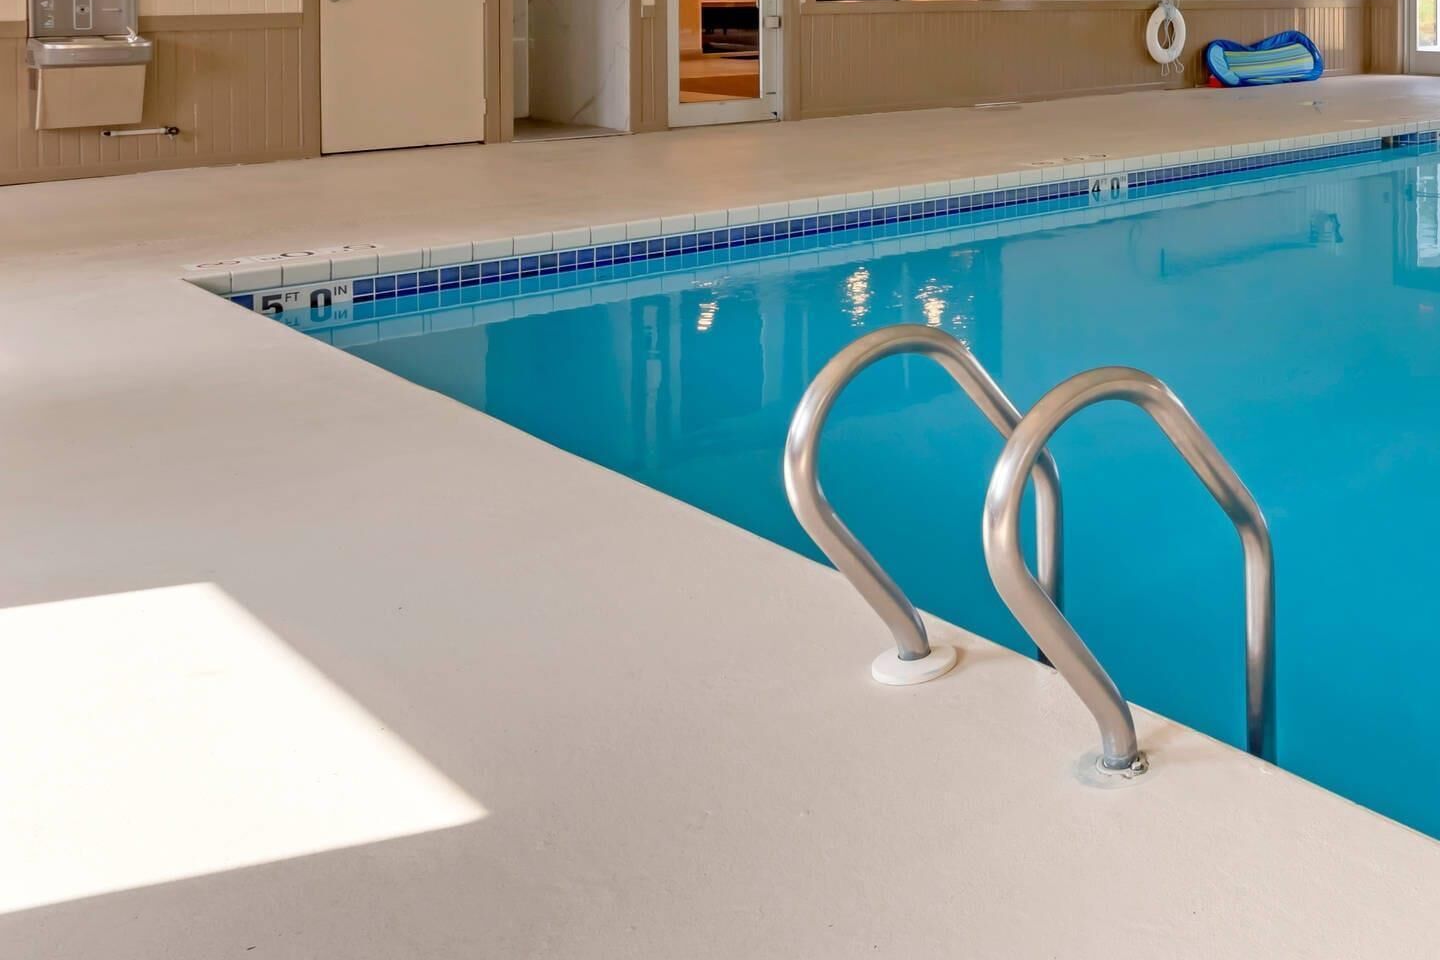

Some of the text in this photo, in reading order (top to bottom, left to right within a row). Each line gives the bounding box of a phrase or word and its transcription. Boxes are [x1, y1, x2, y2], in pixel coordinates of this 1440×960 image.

[1092, 179, 1101, 193] 4
[262, 284, 348, 318] 5 FT 0 IN
